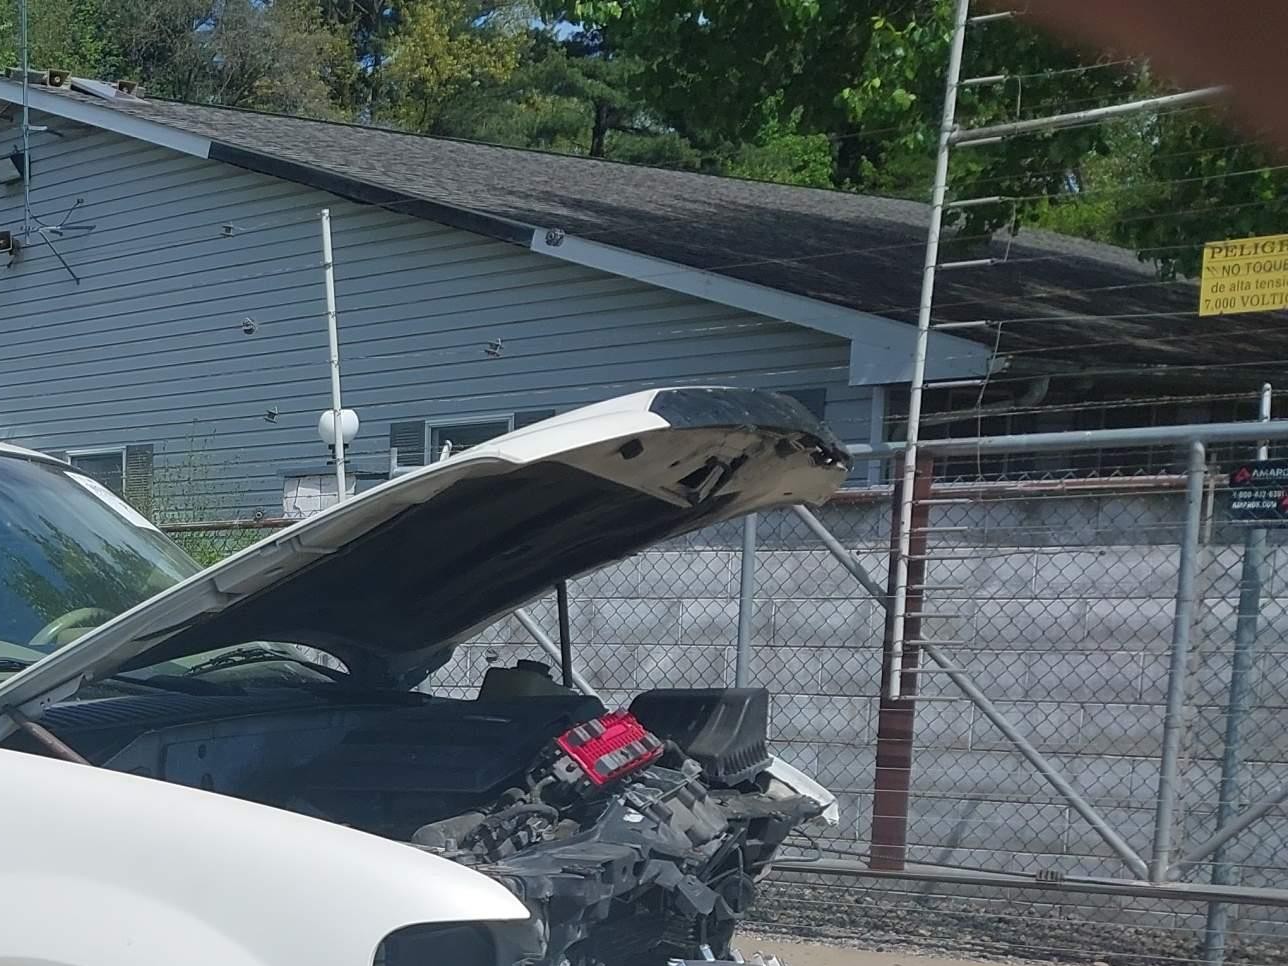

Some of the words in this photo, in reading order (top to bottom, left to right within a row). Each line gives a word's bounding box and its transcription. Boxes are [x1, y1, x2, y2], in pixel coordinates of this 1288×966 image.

[1222, 263, 1241, 277] NO
[1211, 281, 1226, 293] de
[1229, 280, 1251, 292] alta
[1255, 277, 1288, 289] tensi
